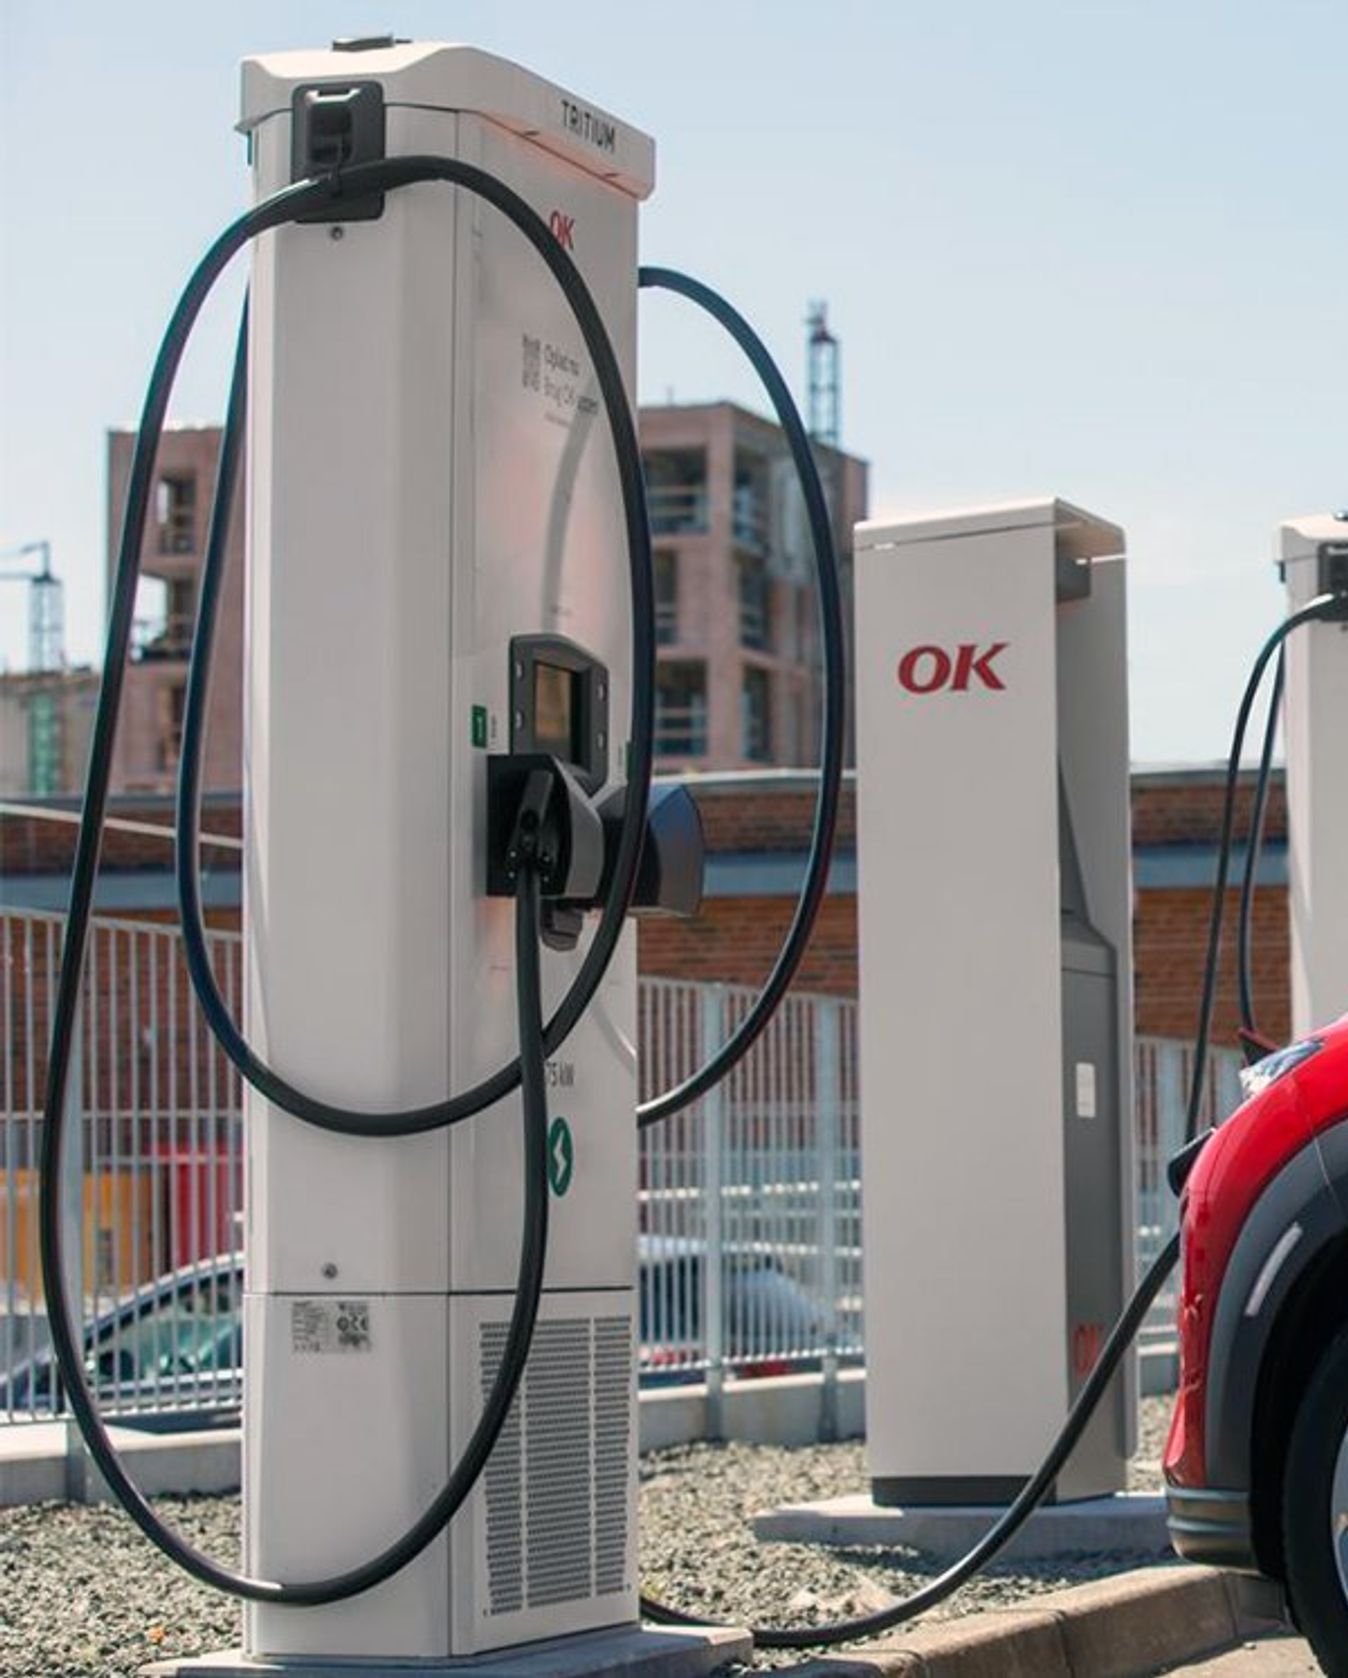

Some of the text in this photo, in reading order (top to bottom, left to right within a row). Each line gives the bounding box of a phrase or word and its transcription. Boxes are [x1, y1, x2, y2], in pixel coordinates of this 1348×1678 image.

[561, 99, 616, 154] TRITIUM
[550, 211, 575, 250] OK
[898, 641, 1010, 694] OK
